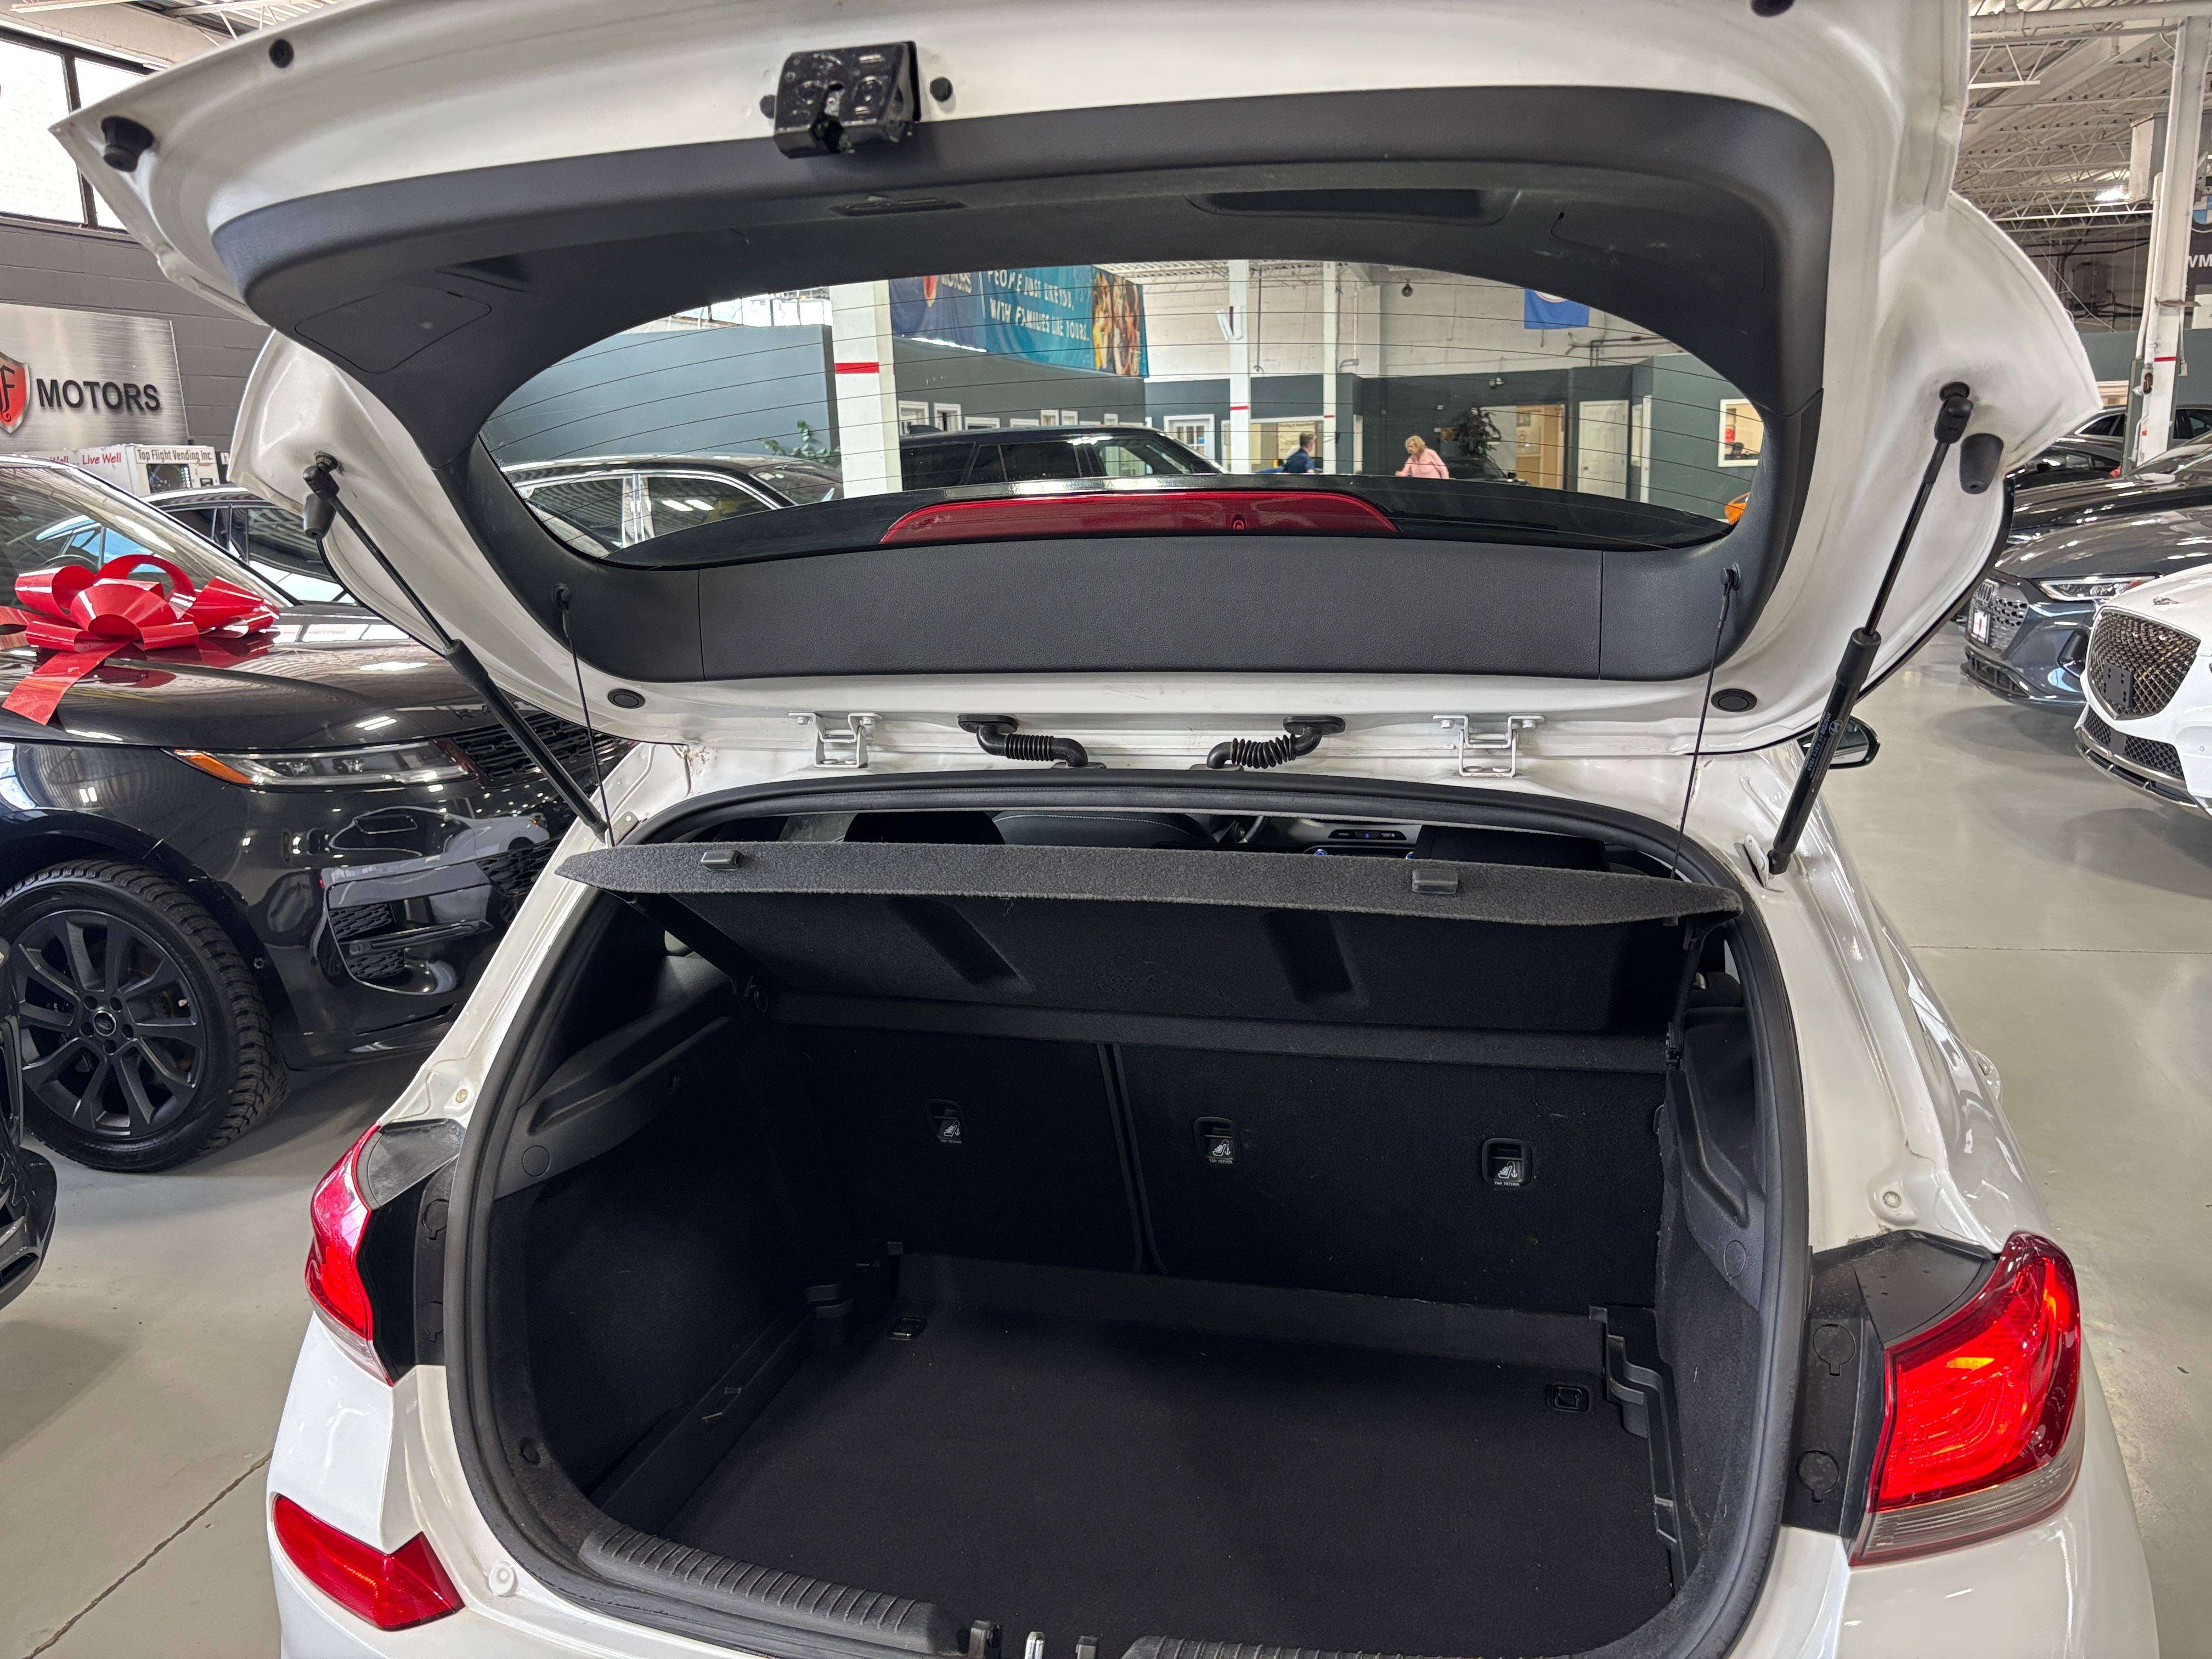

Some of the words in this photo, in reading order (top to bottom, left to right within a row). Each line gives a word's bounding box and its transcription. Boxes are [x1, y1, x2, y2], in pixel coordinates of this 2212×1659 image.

[990, 298, 1012, 323] WITH
[36, 379, 161, 411] MOTORS
[82, 455, 100, 465] Live
[101, 453, 121, 464] Well
[137, 449, 150, 462] Top
[151, 449, 172, 462] Flight
[172, 449, 200, 462] Vending
[201, 450, 213, 460] Inc.
